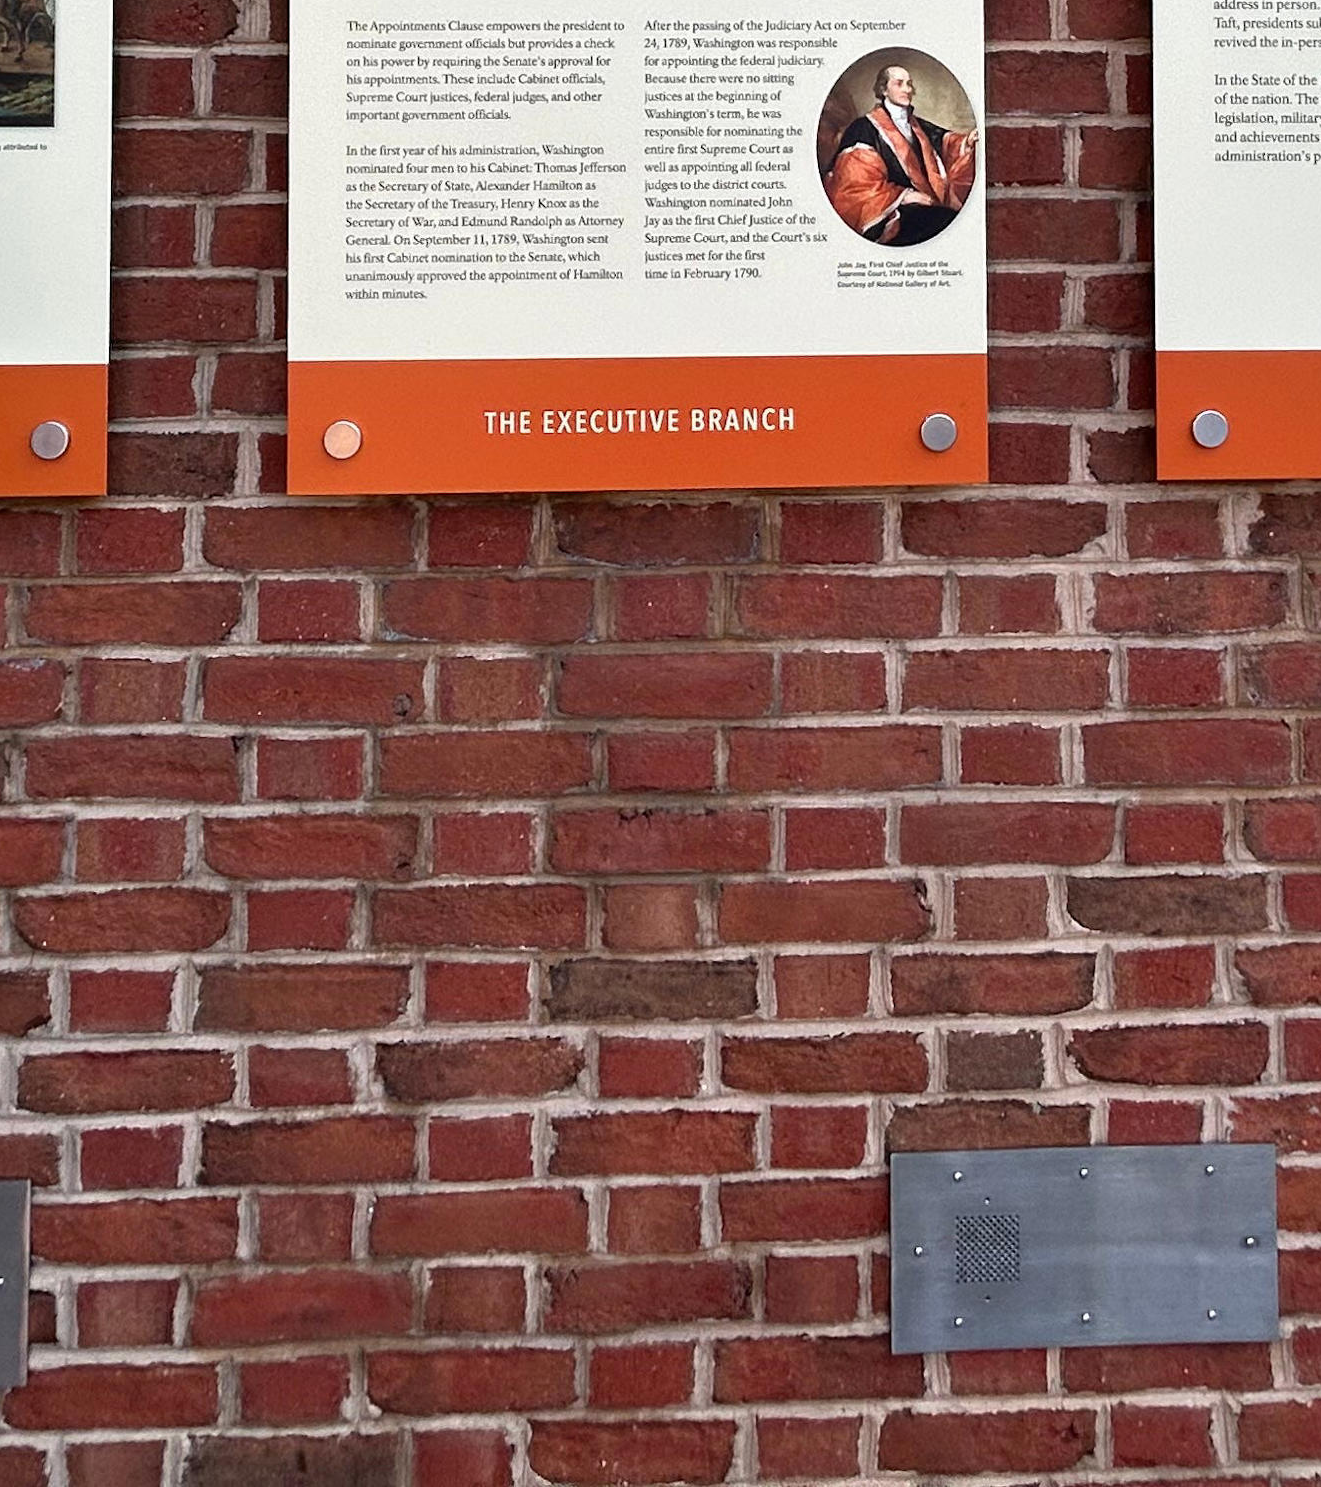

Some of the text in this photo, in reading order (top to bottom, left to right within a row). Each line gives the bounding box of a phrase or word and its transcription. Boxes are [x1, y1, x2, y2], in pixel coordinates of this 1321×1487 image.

[644, 267, 762, 282] time in February 1790.
[484, 408, 794, 434] THE EXECUTIVE BRANCH
